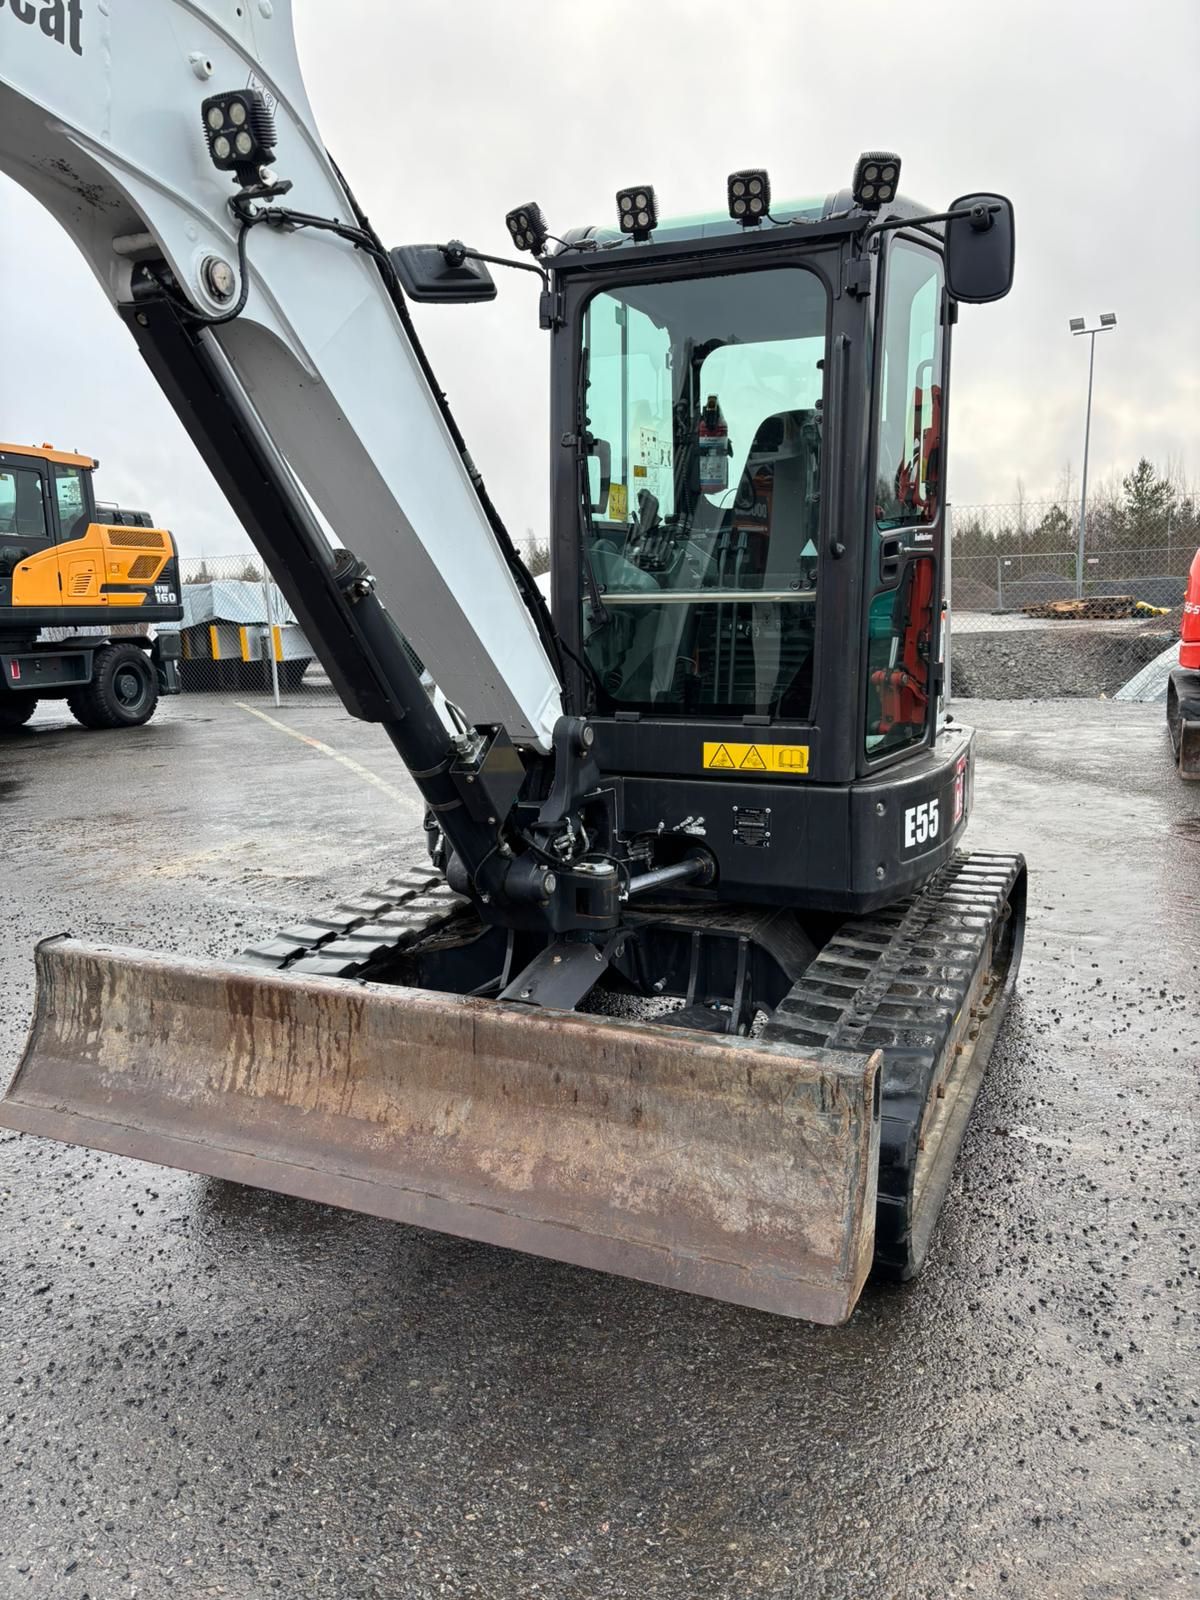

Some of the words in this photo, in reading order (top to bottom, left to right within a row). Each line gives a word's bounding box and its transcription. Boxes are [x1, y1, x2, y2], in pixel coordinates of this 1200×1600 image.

[0, 0, 83, 56] cat
[155, 585, 169, 593] HW
[155, 593, 177, 604] 160
[904, 798, 939, 848] E55
